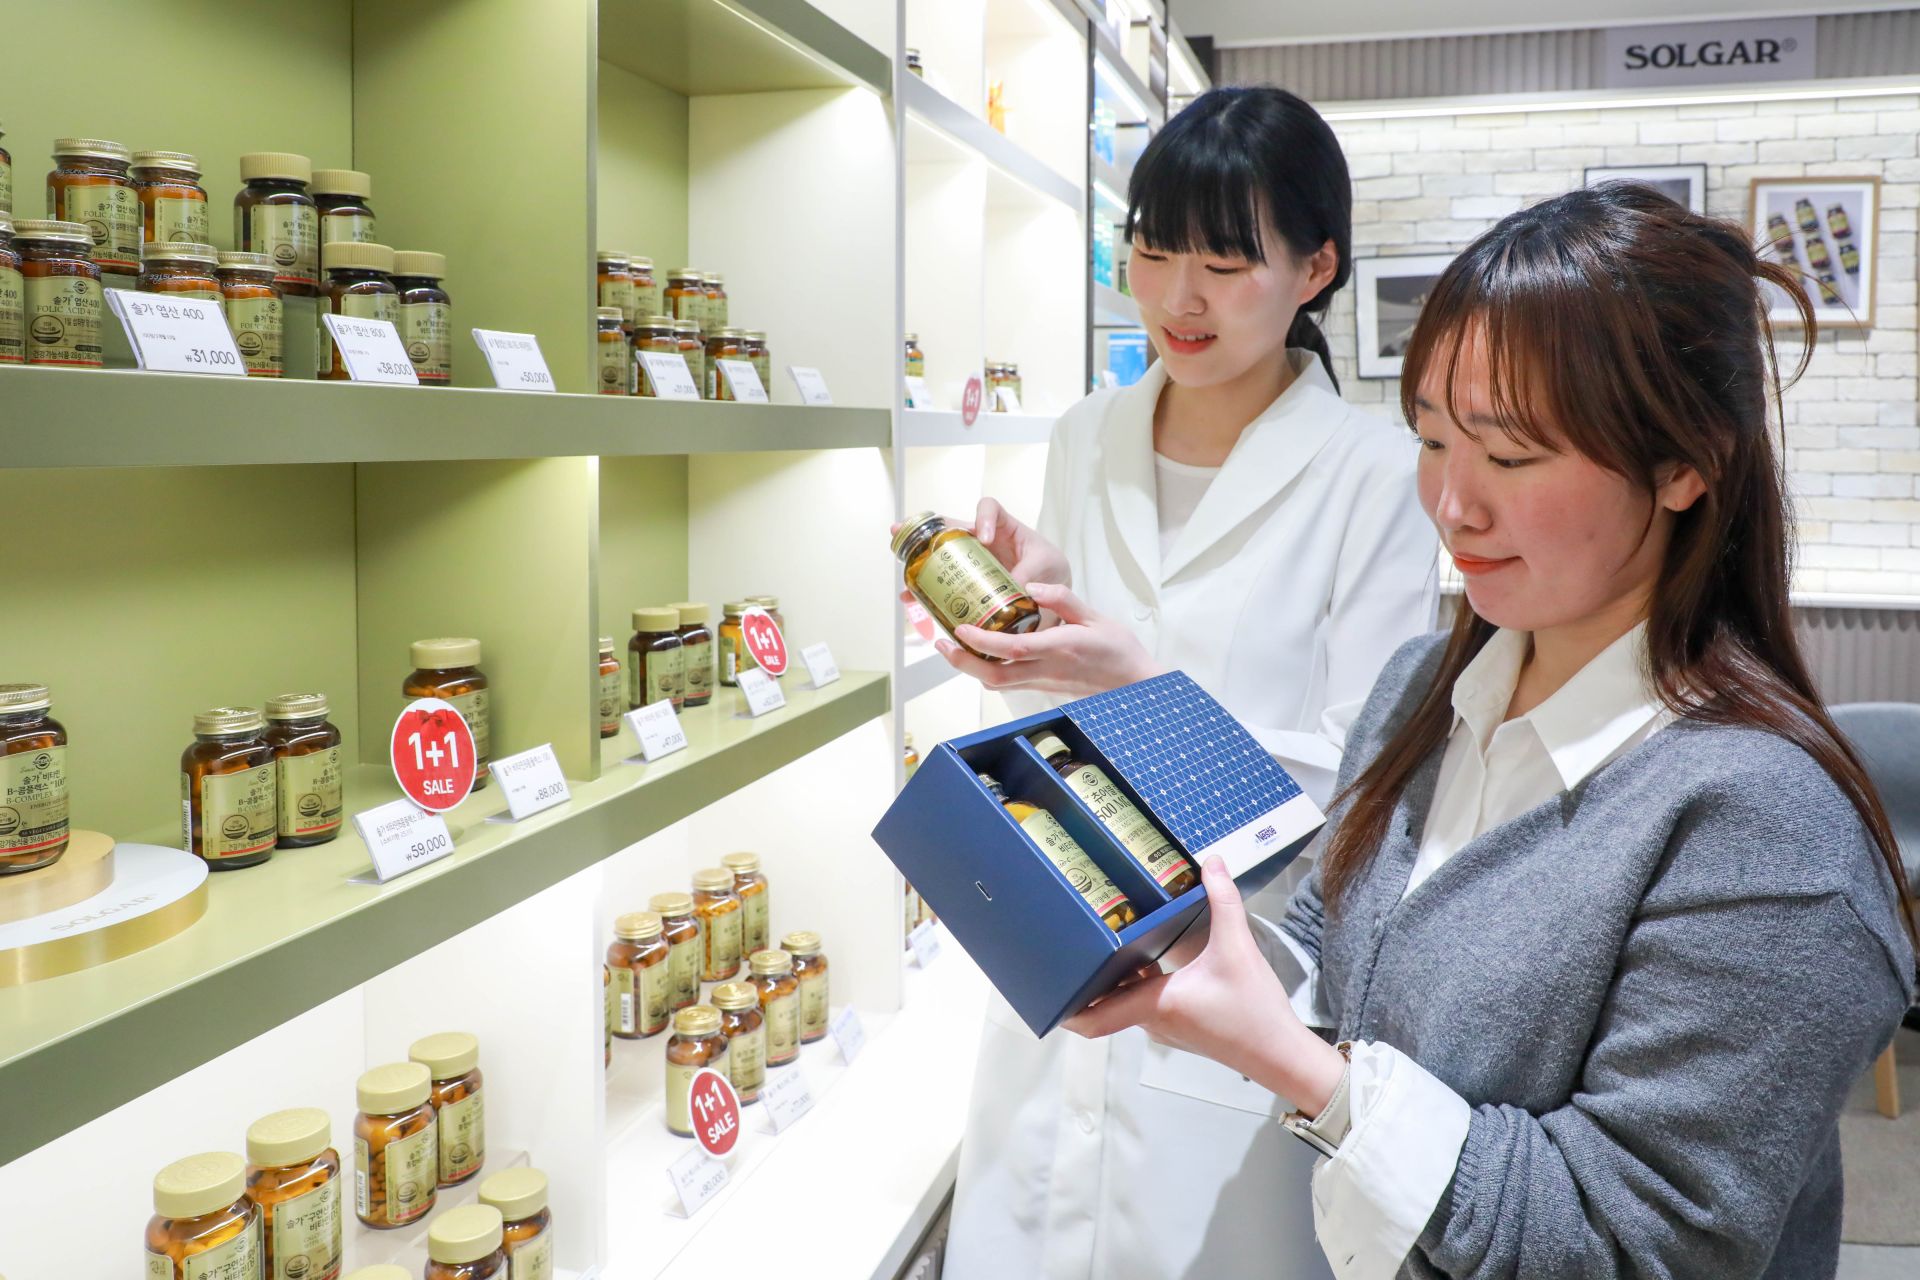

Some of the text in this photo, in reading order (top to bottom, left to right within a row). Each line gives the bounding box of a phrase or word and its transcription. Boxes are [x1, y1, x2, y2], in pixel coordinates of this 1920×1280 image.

[130, 302, 204, 320] 솔가 엽산 400
[185, 348, 236, 366] ₩31,000
[749, 626, 779, 651] 1+1
[408, 731, 459, 770] 1+1
[23, 775, 40, 786] 솔가
[423, 778, 455, 796] SALE
[406, 834, 447, 861] ₩59,000
[695, 1080, 726, 1122] 1+1
[707, 1111, 736, 1145] SALE
